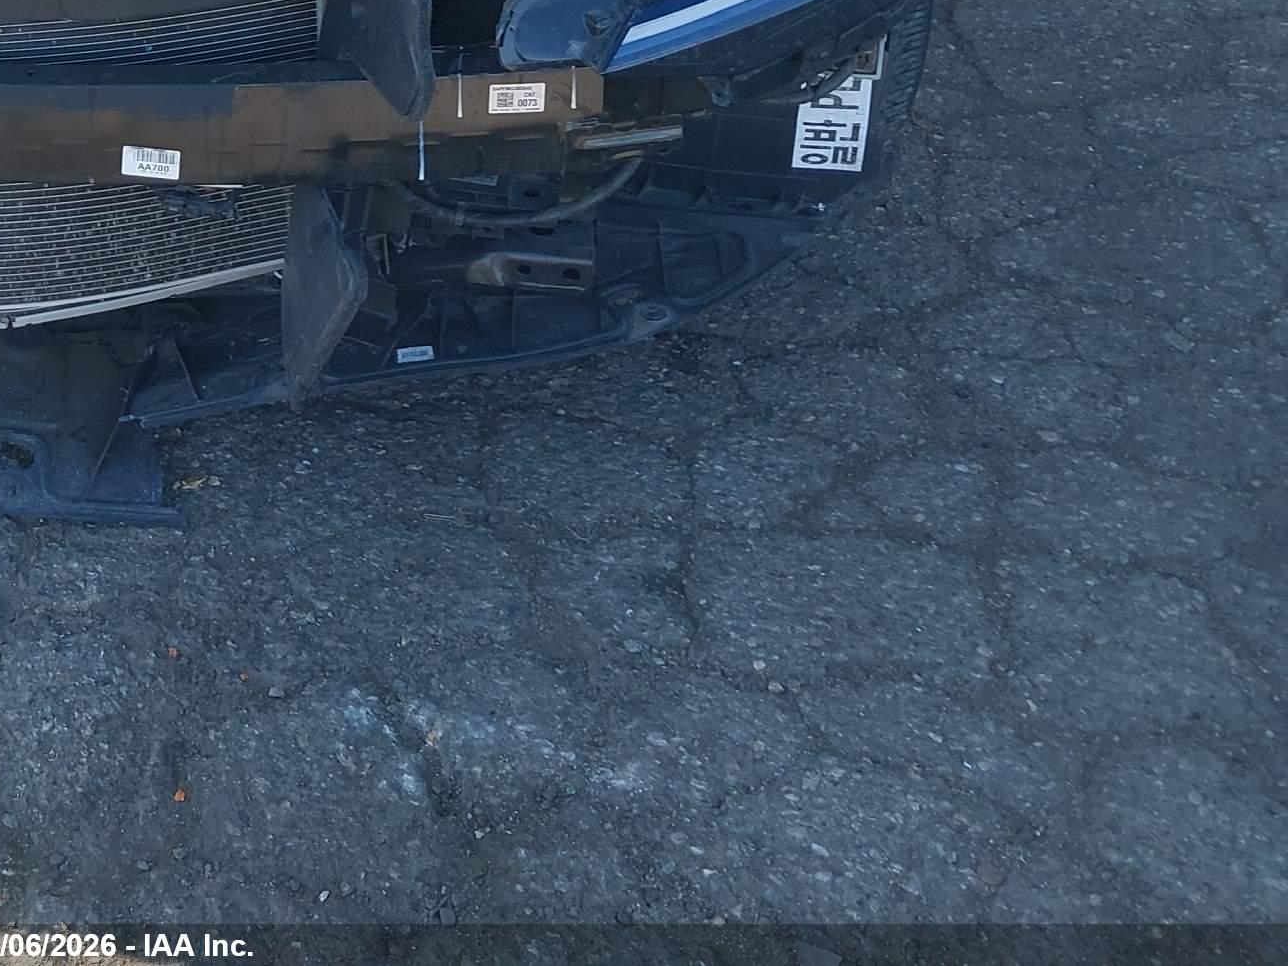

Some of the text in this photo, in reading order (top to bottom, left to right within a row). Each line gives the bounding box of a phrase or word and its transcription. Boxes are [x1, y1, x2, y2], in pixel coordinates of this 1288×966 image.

[517, 98, 538, 107] 0073
[800, 120, 861, 164] 일반
[137, 162, 170, 173] AA700
